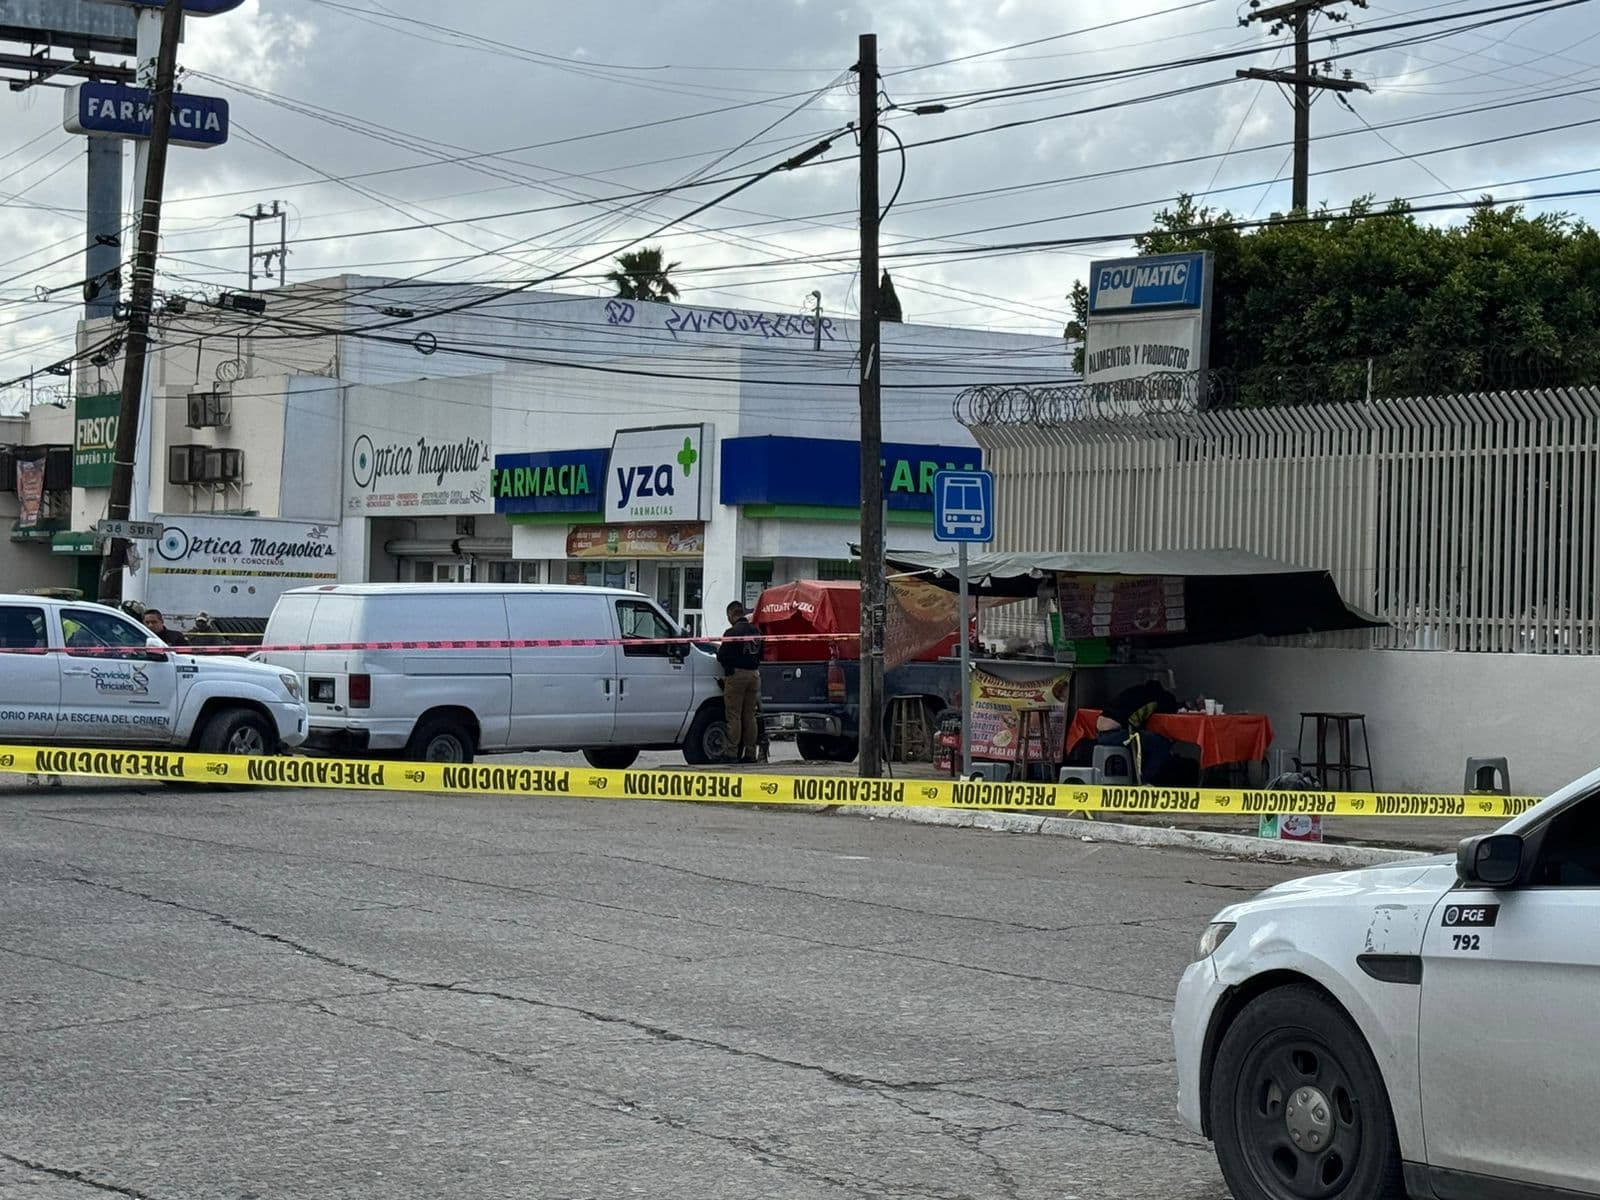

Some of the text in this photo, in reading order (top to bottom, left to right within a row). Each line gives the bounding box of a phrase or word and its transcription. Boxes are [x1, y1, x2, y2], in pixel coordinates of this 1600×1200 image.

[1099, 263, 1187, 291] BOUMATIC
[1088, 344, 1190, 375] ALIMENTOS Y PRODUCTOS
[77, 415, 120, 451] FIRSTC
[102, 452, 107, 464] Y
[417, 436, 490, 486] Magnolia's
[490, 464, 589, 498] FARMACIA
[617, 464, 674, 509] yza
[630, 505, 673, 516] FARMACIAS
[106, 523, 154, 535] 38 SUR
[250, 536, 336, 561] Magnolia's
[241, 558, 284, 566] CONOCENOS
[90, 667, 131, 680] Servicios
[95, 679, 134, 691] Periciales
[0, 710, 170, 726] ORIO PARA LA ESCENA DEL CRIMEN
[36, 750, 185, 777] PRECAUCION
[247, 758, 385, 786] PRECAUCION
[443, 766, 570, 792] PRECAUCION
[624, 773, 743, 798] PRECAUCION
[793, 779, 904, 802] PRECAUCION
[952, 784, 1057, 806] PRECAUCION
[1101, 788, 1200, 809] PRECAUCION
[1242, 792, 1337, 812] PRECAUCION
[1375, 796, 1465, 815] PRECAUCION
[1461, 909, 1486, 922] FGE
[1452, 934, 1480, 951] 792
